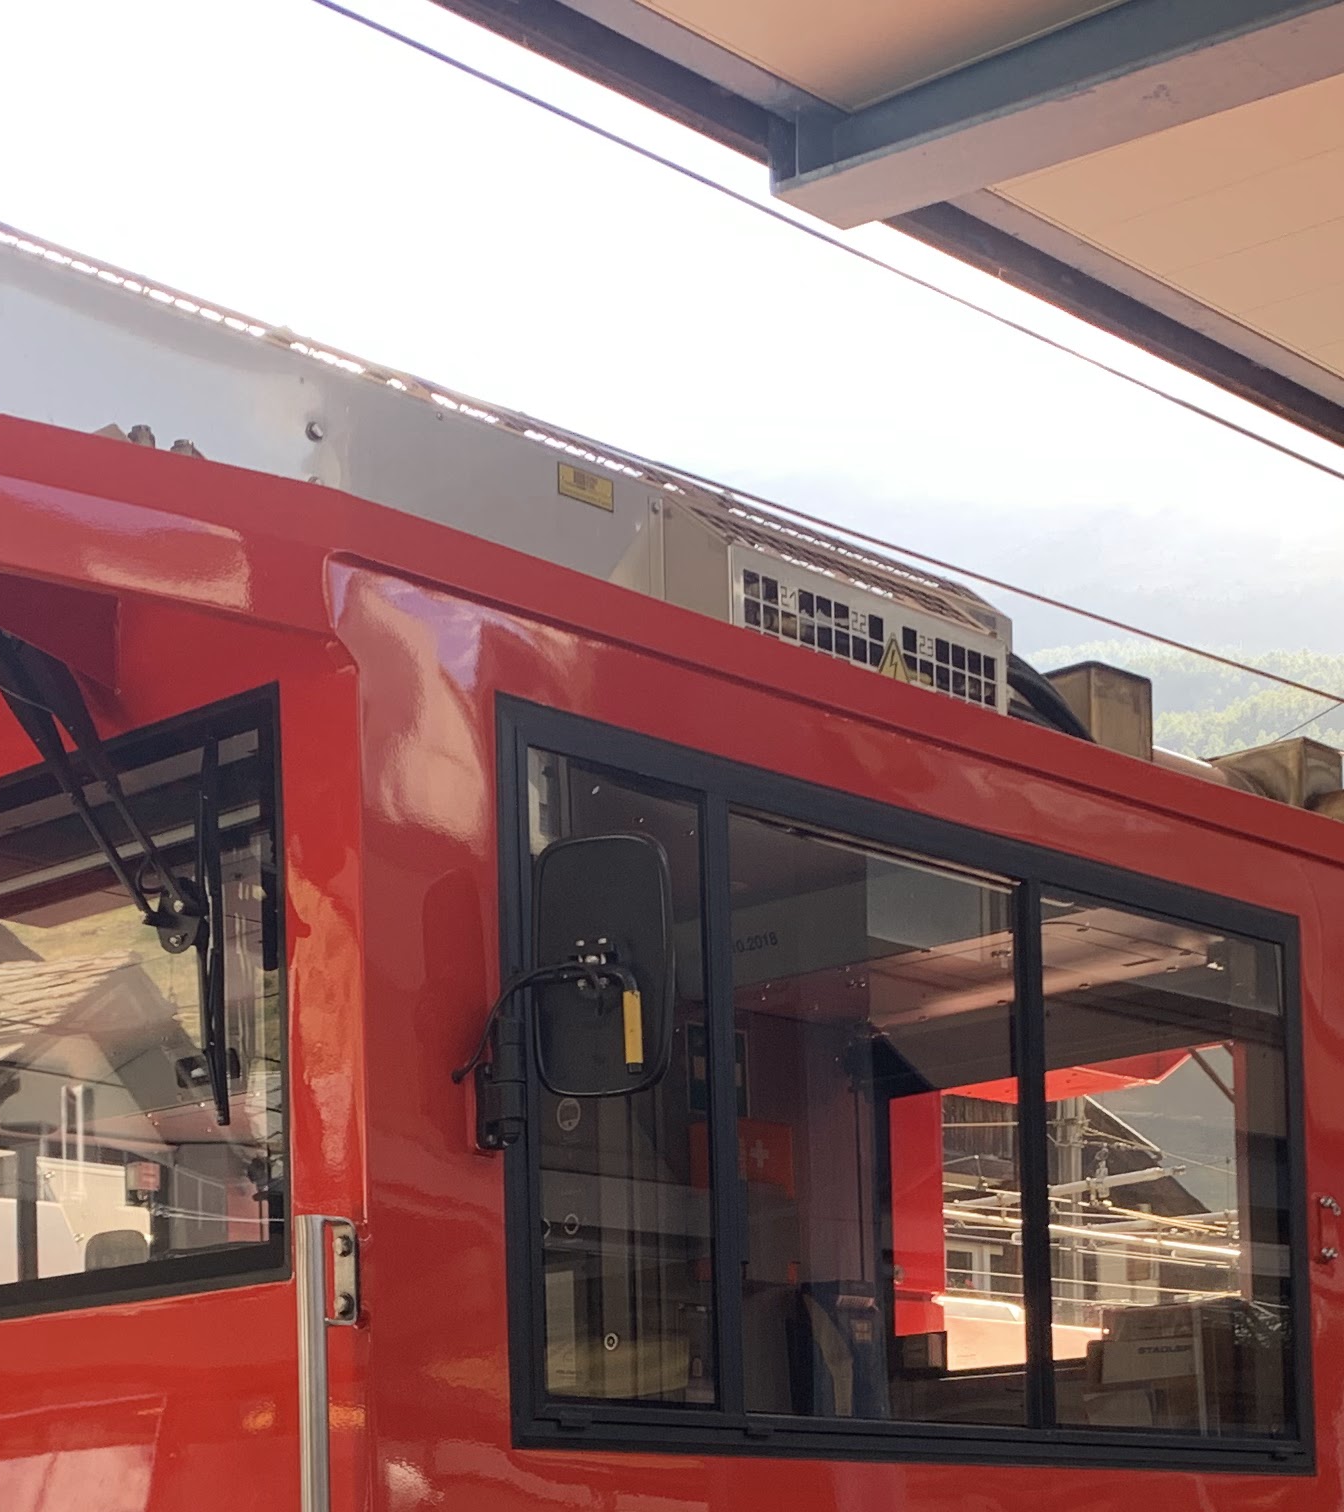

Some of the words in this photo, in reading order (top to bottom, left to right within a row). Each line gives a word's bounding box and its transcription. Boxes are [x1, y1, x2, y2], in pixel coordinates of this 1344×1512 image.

[780, 585, 797, 610] 21
[851, 610, 867, 635] 22
[918, 634, 934, 658] 23
